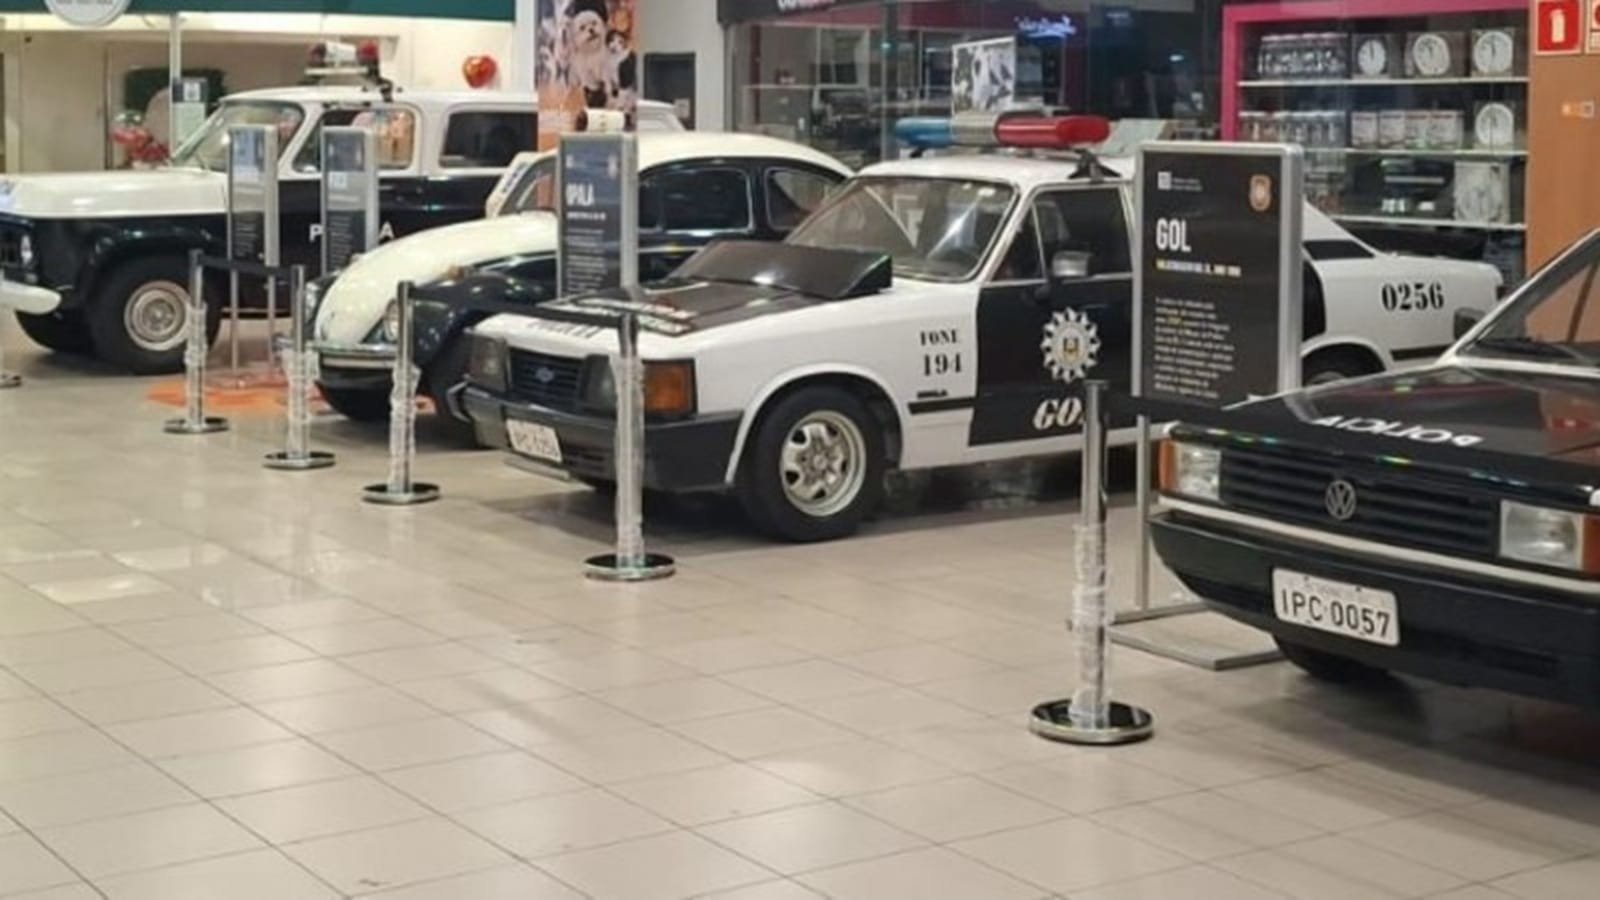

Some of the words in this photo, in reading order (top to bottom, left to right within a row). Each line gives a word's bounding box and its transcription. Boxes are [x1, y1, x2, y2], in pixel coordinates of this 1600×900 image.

[1156, 217, 1191, 252] GOL
[1381, 282, 1444, 312] 0256
[923, 353, 962, 376] 194
[1033, 397, 1086, 430] GO
